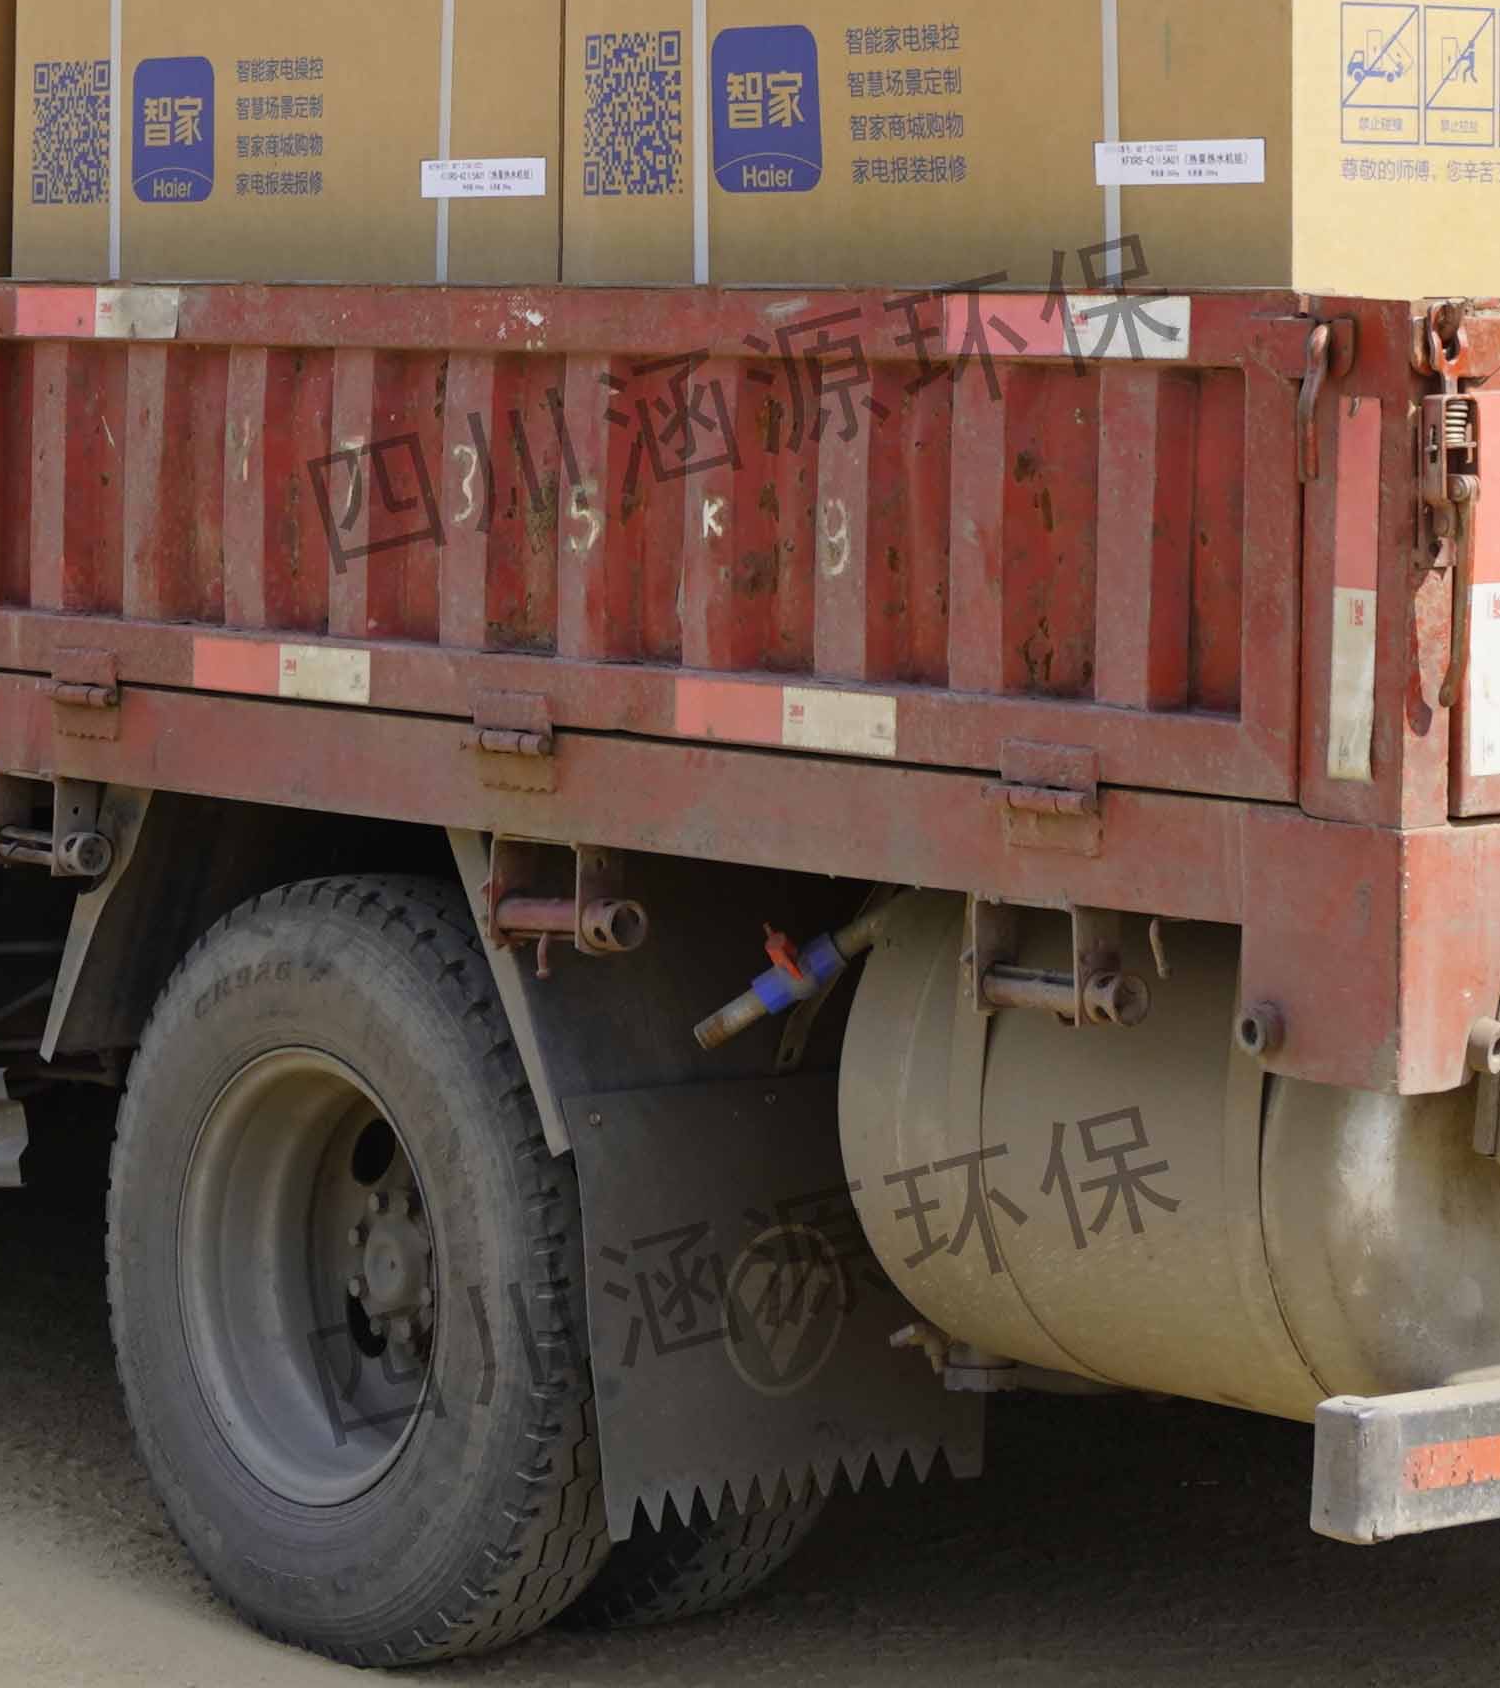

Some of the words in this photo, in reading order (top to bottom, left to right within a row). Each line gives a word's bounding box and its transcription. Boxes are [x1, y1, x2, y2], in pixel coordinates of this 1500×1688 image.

[845, 23, 961, 55] 智能家电操控
[236, 57, 323, 83] 智能家电操控
[847, 67, 963, 98] 智慧场景定制
[236, 94, 323, 120] 智慧场景定制
[727, 71, 804, 129] 智家
[144, 96, 203, 146] 智家
[850, 111, 965, 141] 智家商城购物
[237, 133, 323, 158] 智家商城购物
[236, 170, 323, 196] 家电报装报修
[743, 164, 794, 189] Haier
[852, 155, 968, 185] 家电报装报修
[154, 177, 192, 198] Haier
